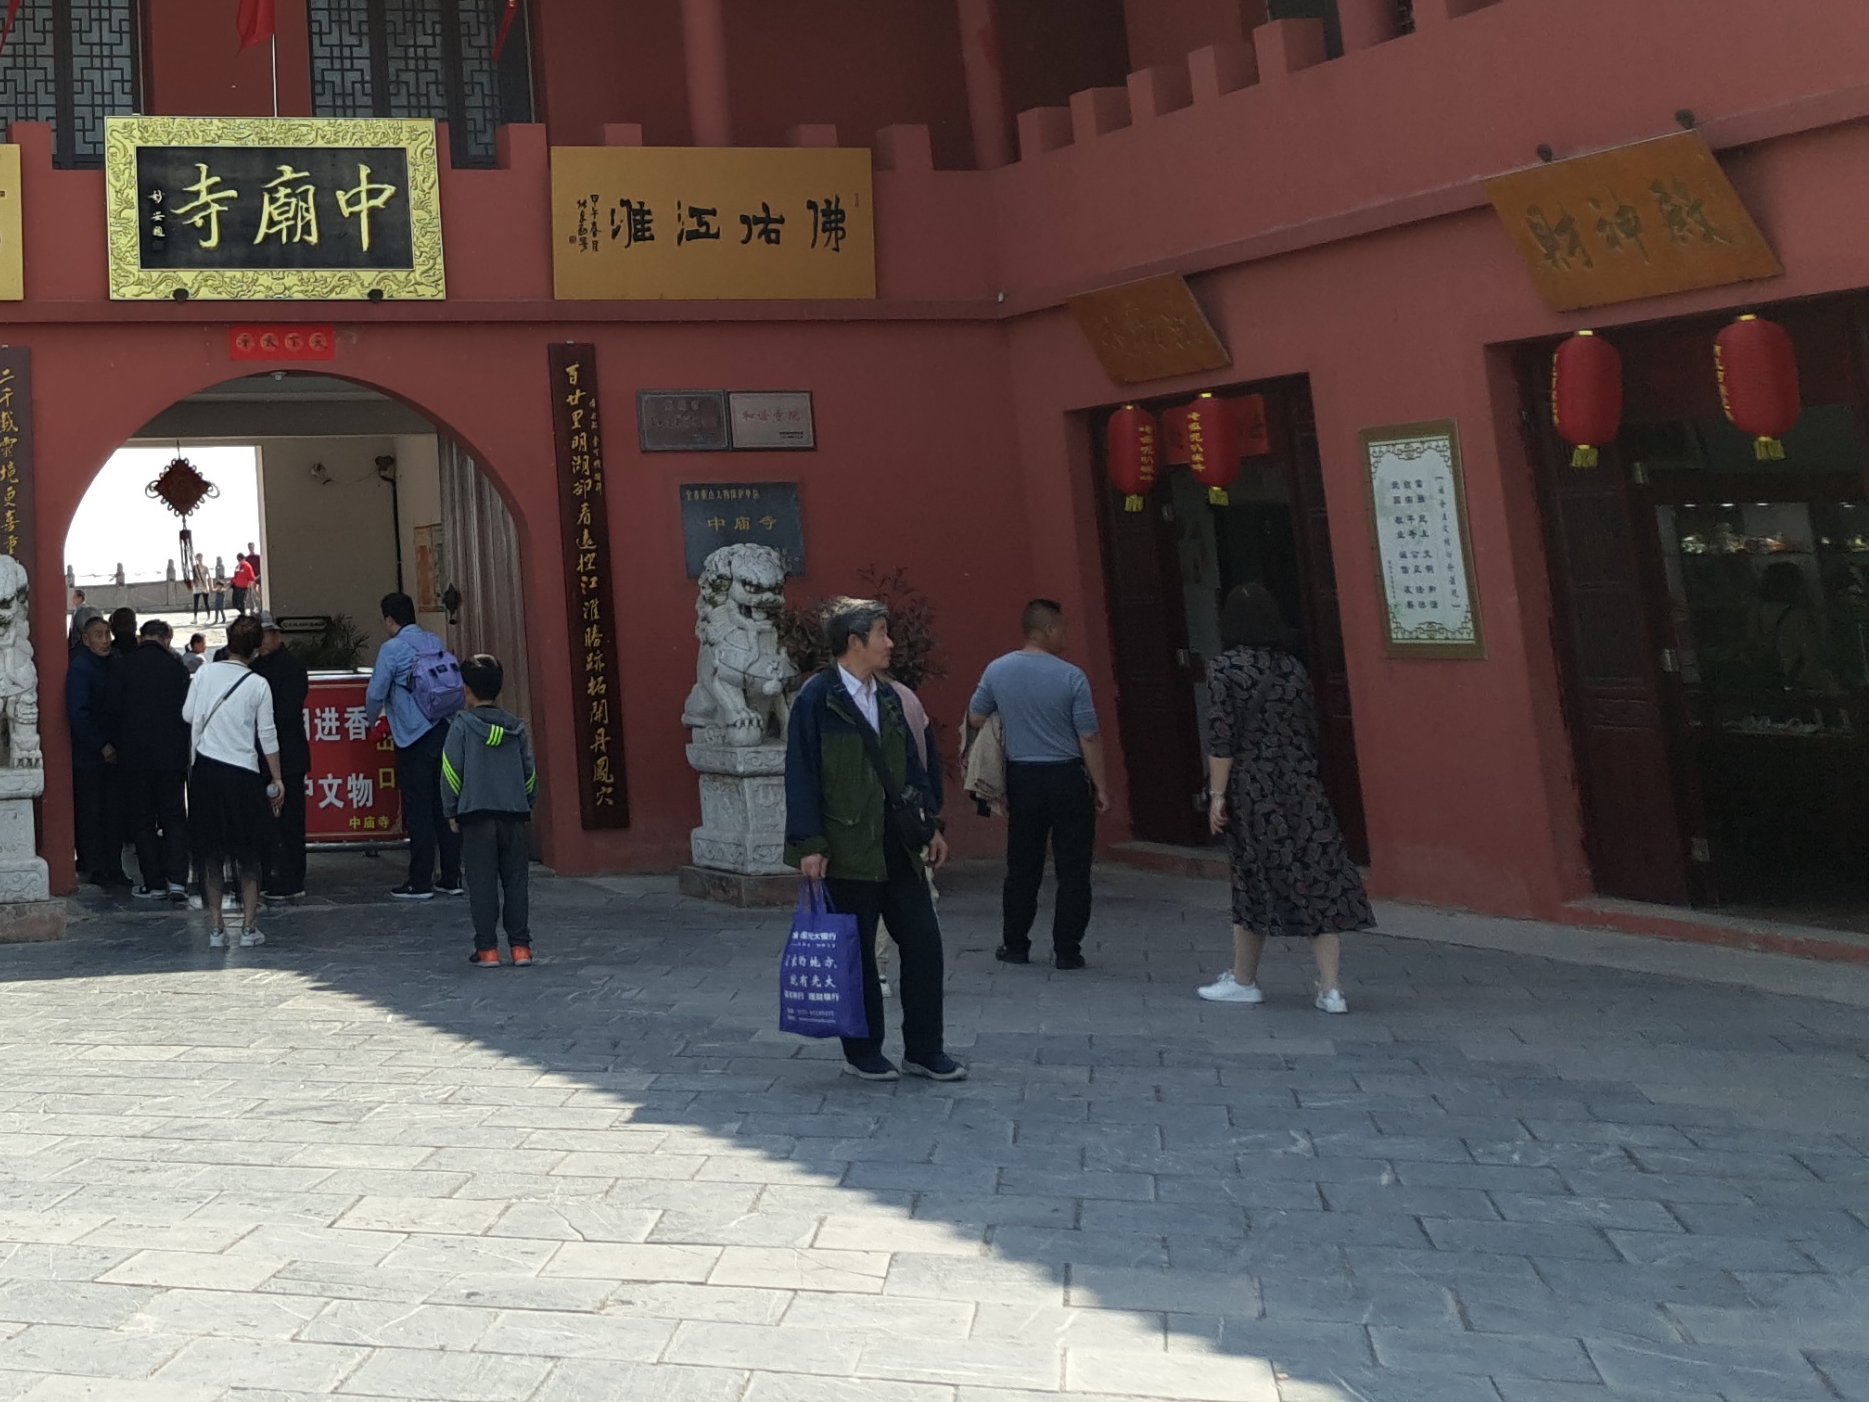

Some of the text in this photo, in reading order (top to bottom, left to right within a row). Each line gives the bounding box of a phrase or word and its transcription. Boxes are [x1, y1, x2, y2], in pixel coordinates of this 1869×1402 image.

[707, 515, 777, 532] 中庙寺
[349, 816, 390, 830] 中庙寺
